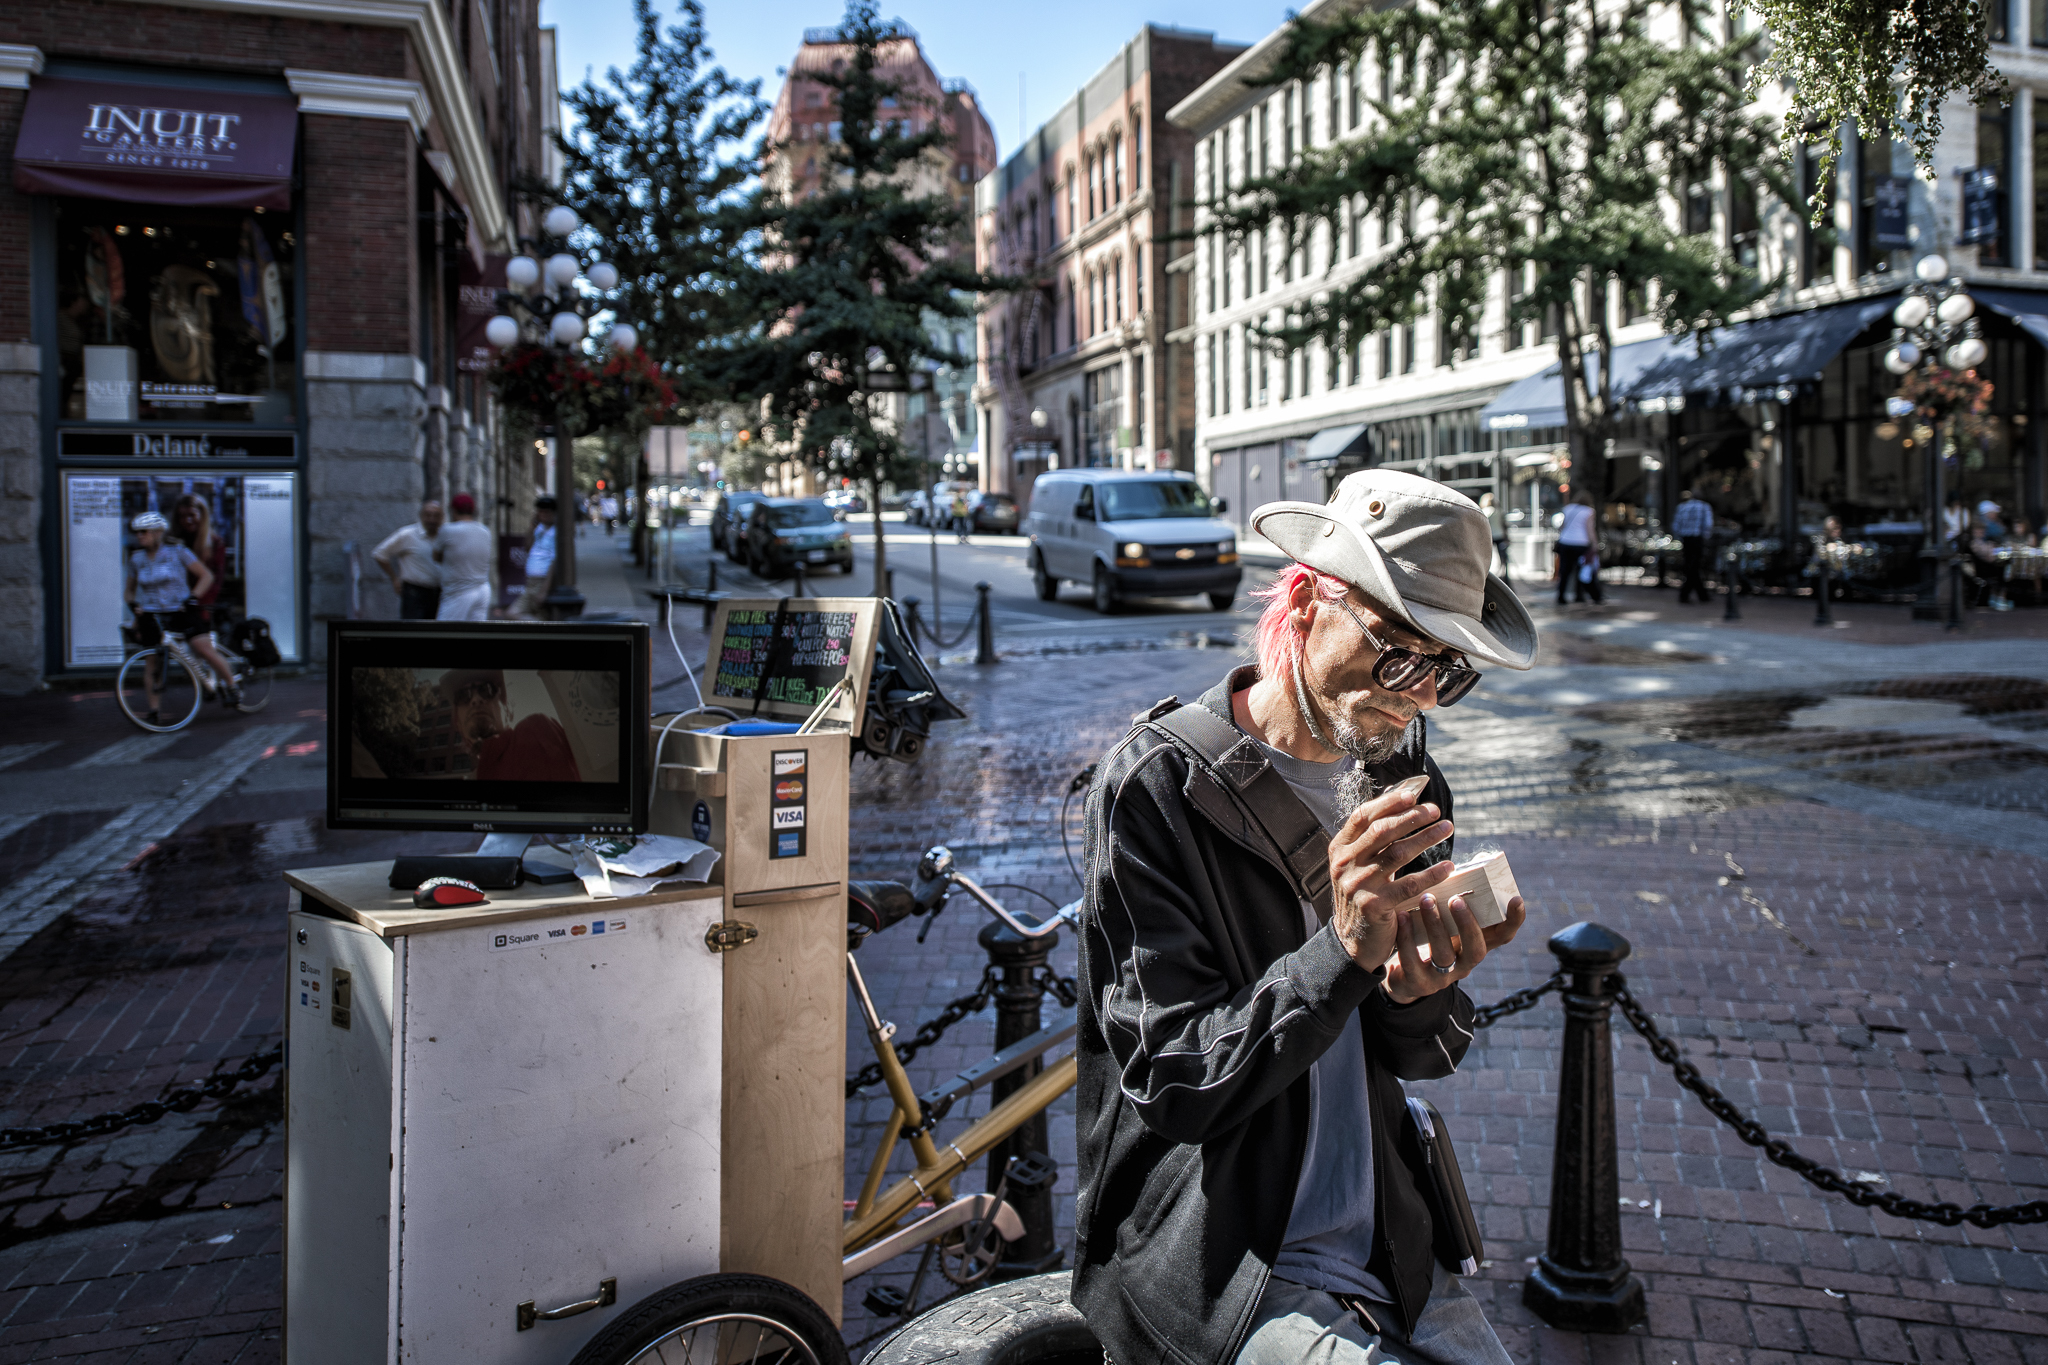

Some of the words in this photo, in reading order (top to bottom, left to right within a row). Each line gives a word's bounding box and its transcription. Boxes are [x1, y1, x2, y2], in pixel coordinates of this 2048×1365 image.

[84, 103, 241, 140] INUIT
[95, 130, 221, 152] GALLERY
[105, 153, 163, 166] SINCE
[140, 380, 218, 395] Entrance
[132, 433, 212, 457] Delané
[820, 612, 851, 626] COFFEE
[826, 624, 850, 639] WATER
[723, 648, 751, 664] SCONES
[775, 811, 803, 823] VISA
[473, 823, 494, 832] DELL
[508, 932, 539, 945] Square
[547, 928, 566, 938] VISA
